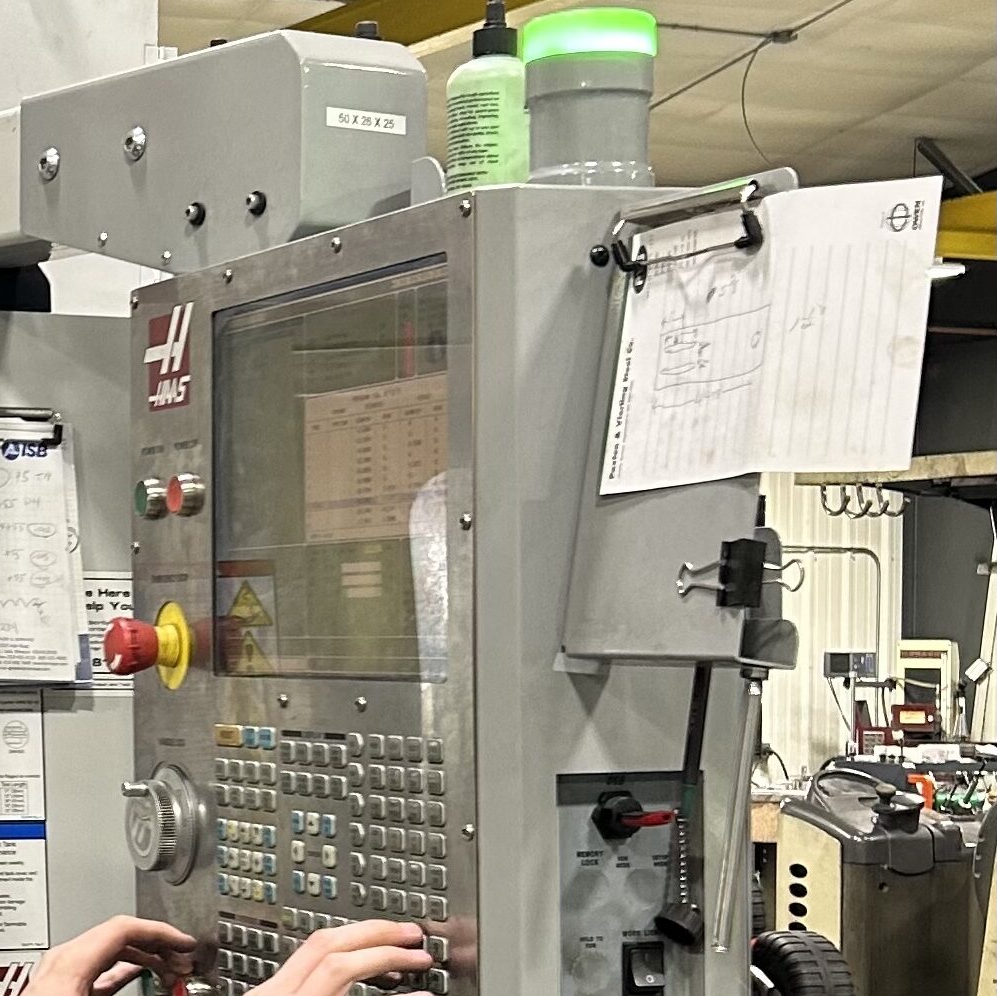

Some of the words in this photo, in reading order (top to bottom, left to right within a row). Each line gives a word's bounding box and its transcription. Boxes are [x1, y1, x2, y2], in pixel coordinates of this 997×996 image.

[352, 115, 358, 124] X
[374, 118, 380, 127] X
[383, 119, 394, 129] 25
[98, 589, 130, 597] Here
